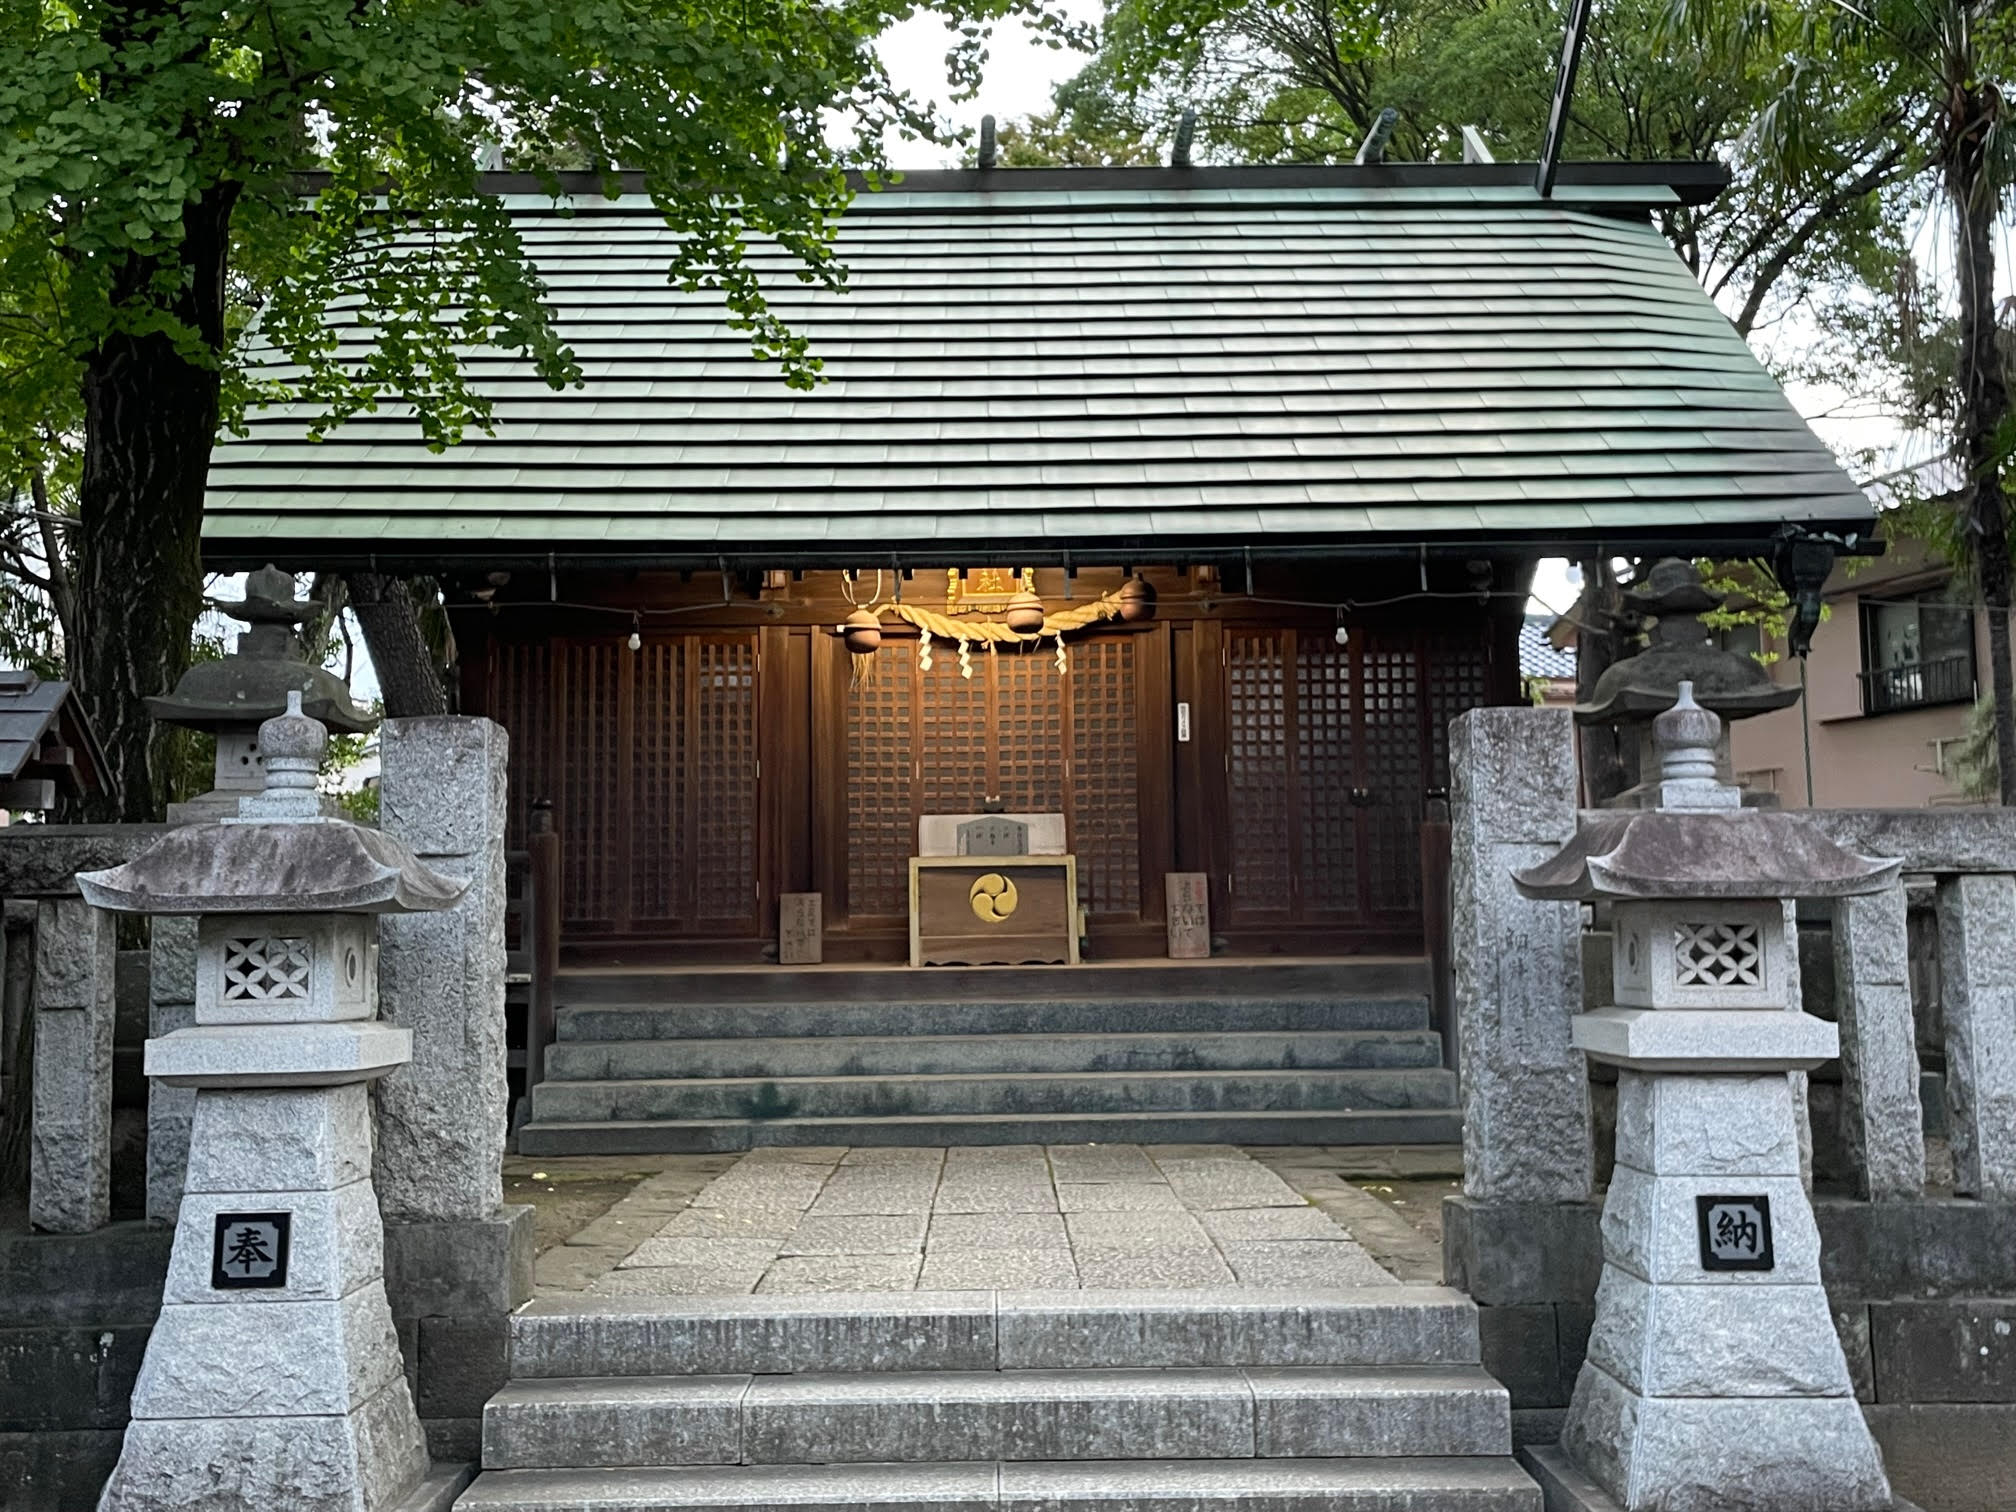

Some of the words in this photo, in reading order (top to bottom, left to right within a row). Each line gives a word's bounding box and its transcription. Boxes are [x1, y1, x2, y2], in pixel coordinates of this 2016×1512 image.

[976, 568, 1004, 592] 社
[225, 1226, 274, 1275] 奉
[1714, 1210, 1757, 1254] 納
